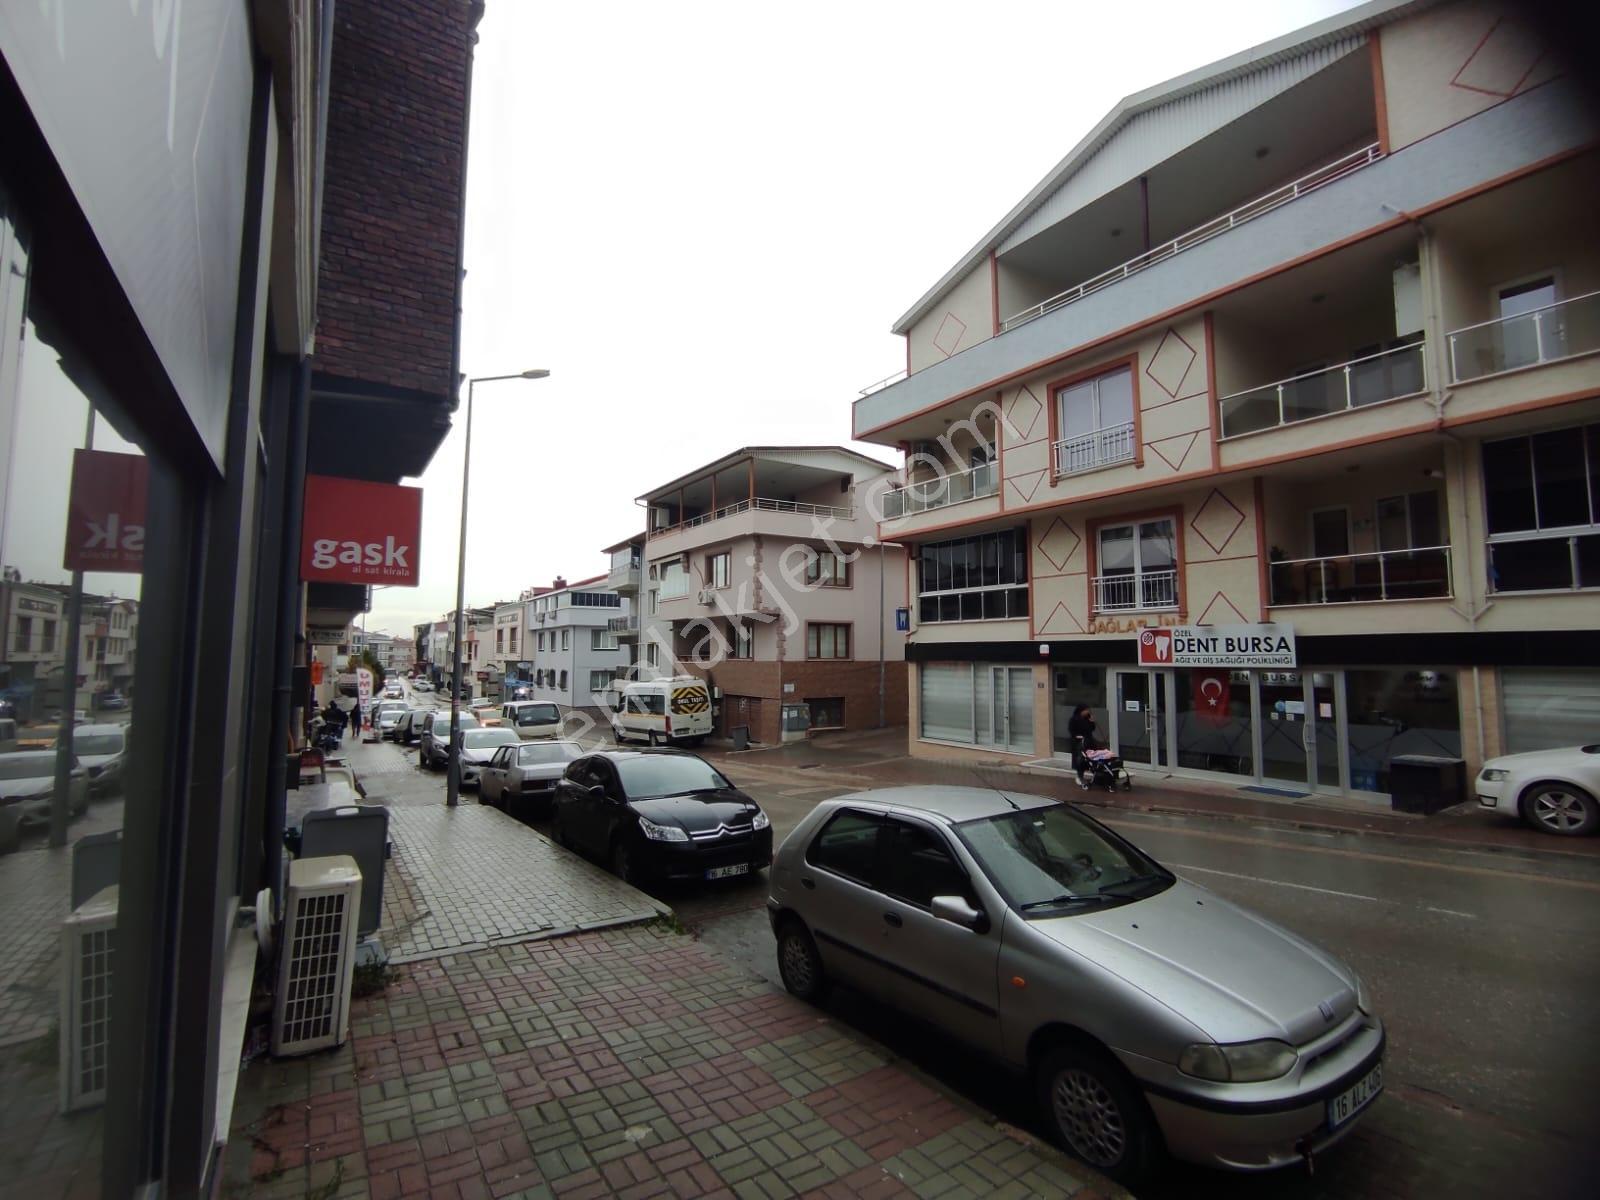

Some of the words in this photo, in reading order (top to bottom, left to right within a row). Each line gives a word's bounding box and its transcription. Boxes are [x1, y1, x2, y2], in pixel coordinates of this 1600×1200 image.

[312, 535, 409, 569] gask
[1174, 629, 1192, 637] ÖZEL
[1174, 638, 1219, 653] DENT
[1226, 636, 1291, 653] BURSA
[1192, 656, 1201, 664] VE
[1336, 1095, 1348, 1119] 16
